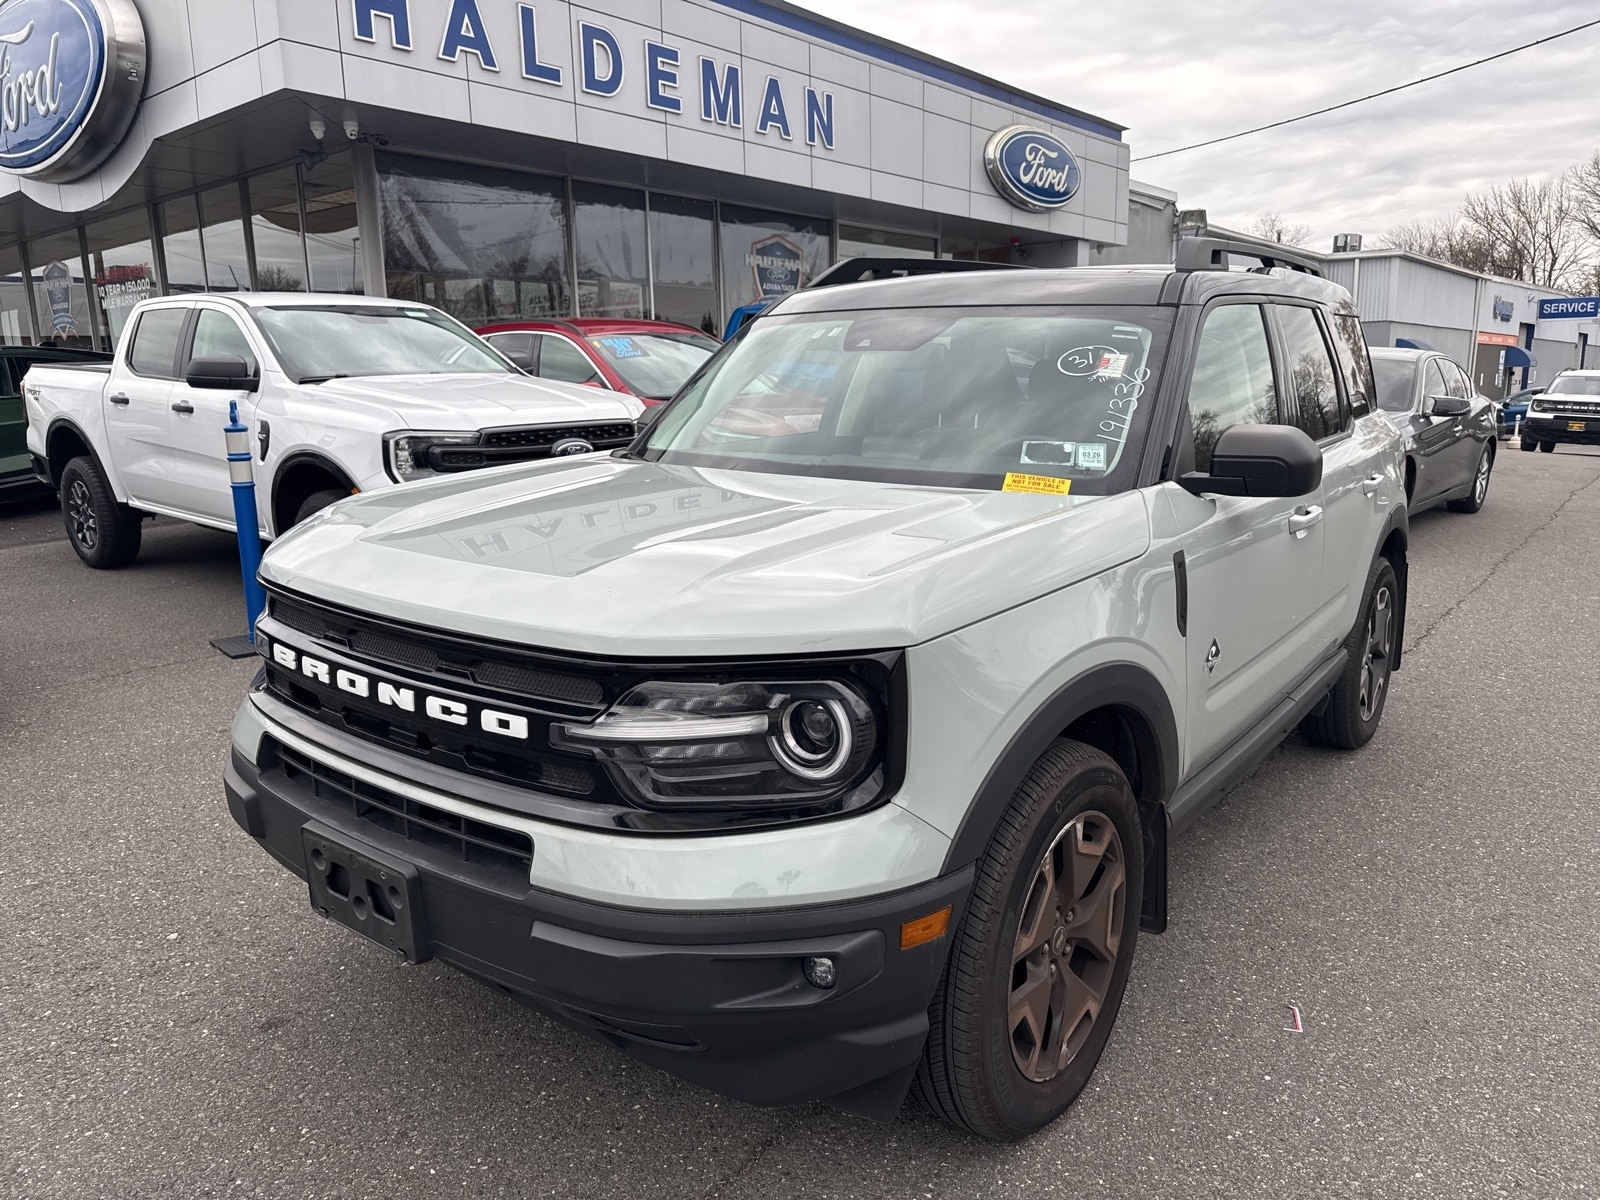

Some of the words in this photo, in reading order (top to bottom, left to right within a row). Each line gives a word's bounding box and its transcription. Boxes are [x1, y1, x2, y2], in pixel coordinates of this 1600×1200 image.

[353, 0, 834, 150] HALDEMAN
[1020, 143, 1069, 193] Ford
[105, 283, 121, 297] YEAR
[125, 278, 150, 293] 150,000
[1543, 302, 1596, 314] SERVICE
[1068, 351, 1093, 369] 31
[272, 642, 529, 741] BRONCO
